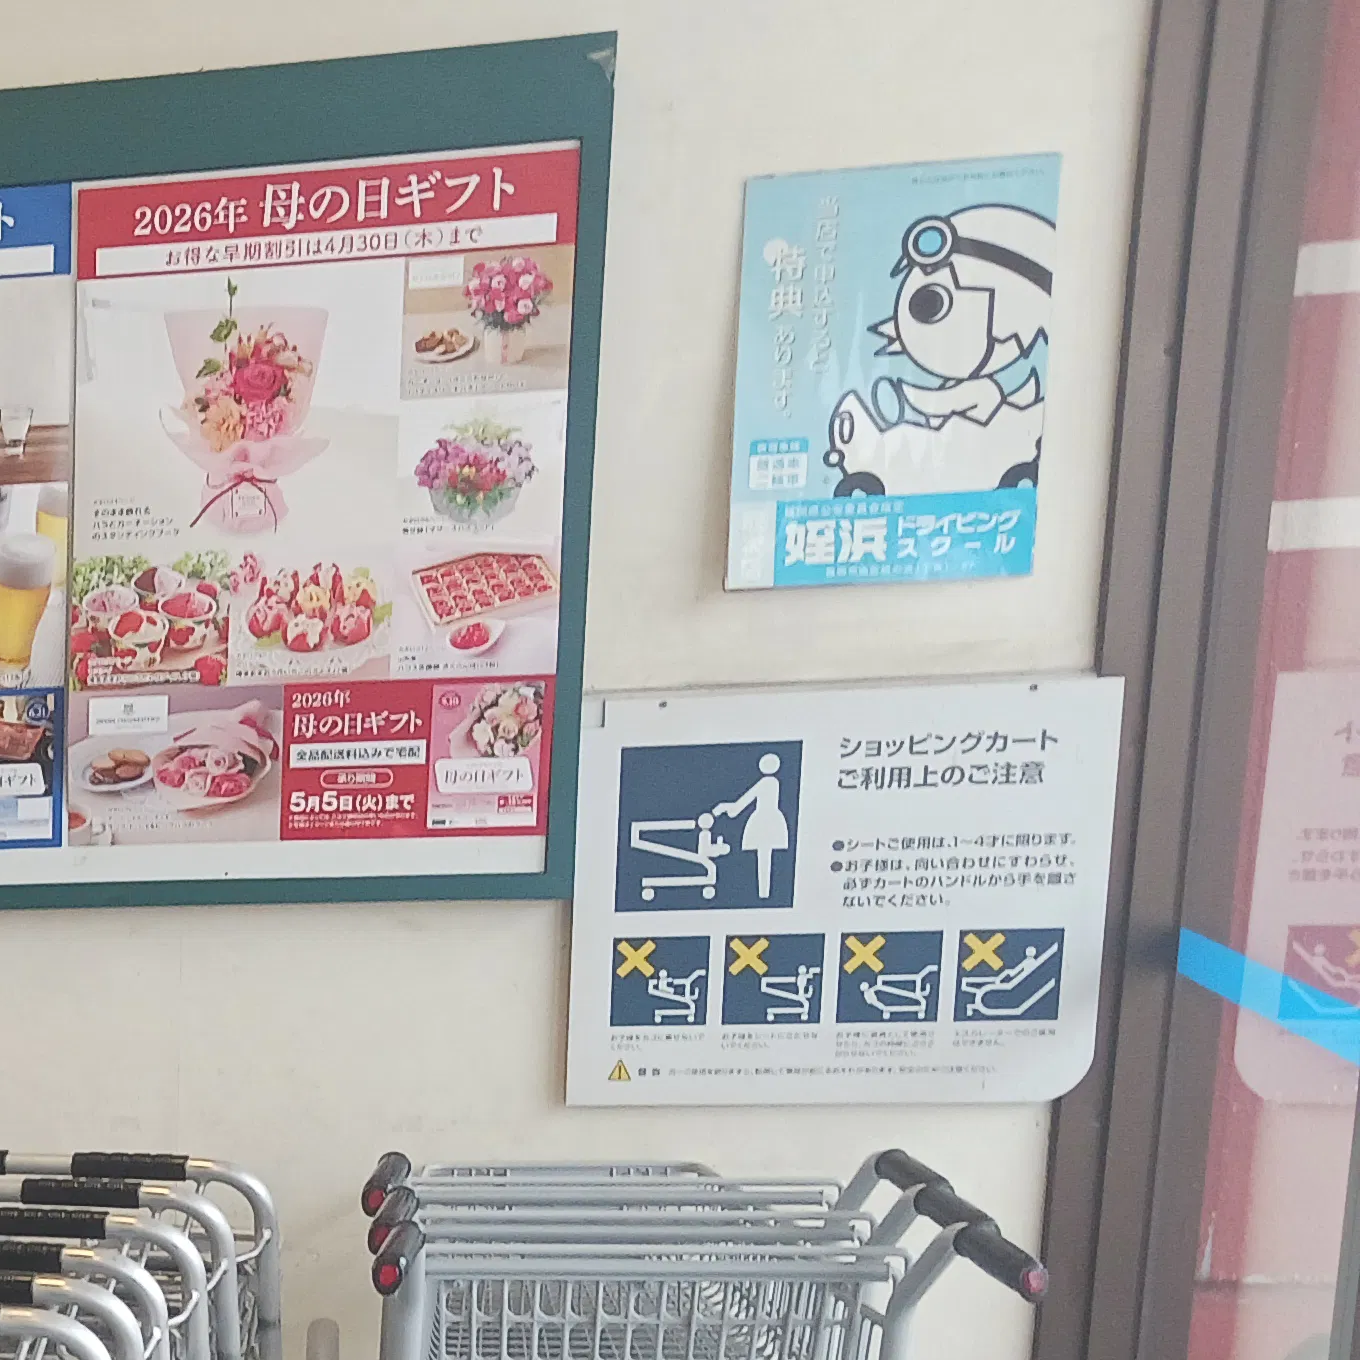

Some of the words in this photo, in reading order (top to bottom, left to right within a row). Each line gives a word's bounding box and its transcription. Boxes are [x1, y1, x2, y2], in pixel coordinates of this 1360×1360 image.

[133, 197, 248, 237] 2026年
[260, 166, 516, 232] 母の日ギフト
[897, 509, 1022, 538] ドライビング
[785, 515, 888, 566] 姪浜
[895, 532, 1017, 559] スクール
[292, 690, 351, 709] 2026年
[292, 711, 423, 738] 母の日ギフト
[838, 730, 1059, 760] ショッピングカート
[444, 767, 524, 786] 母の日ギフト
[836, 760, 1046, 790] ご利用上のご注意
[289, 791, 414, 813] 5月5日(火)まで
